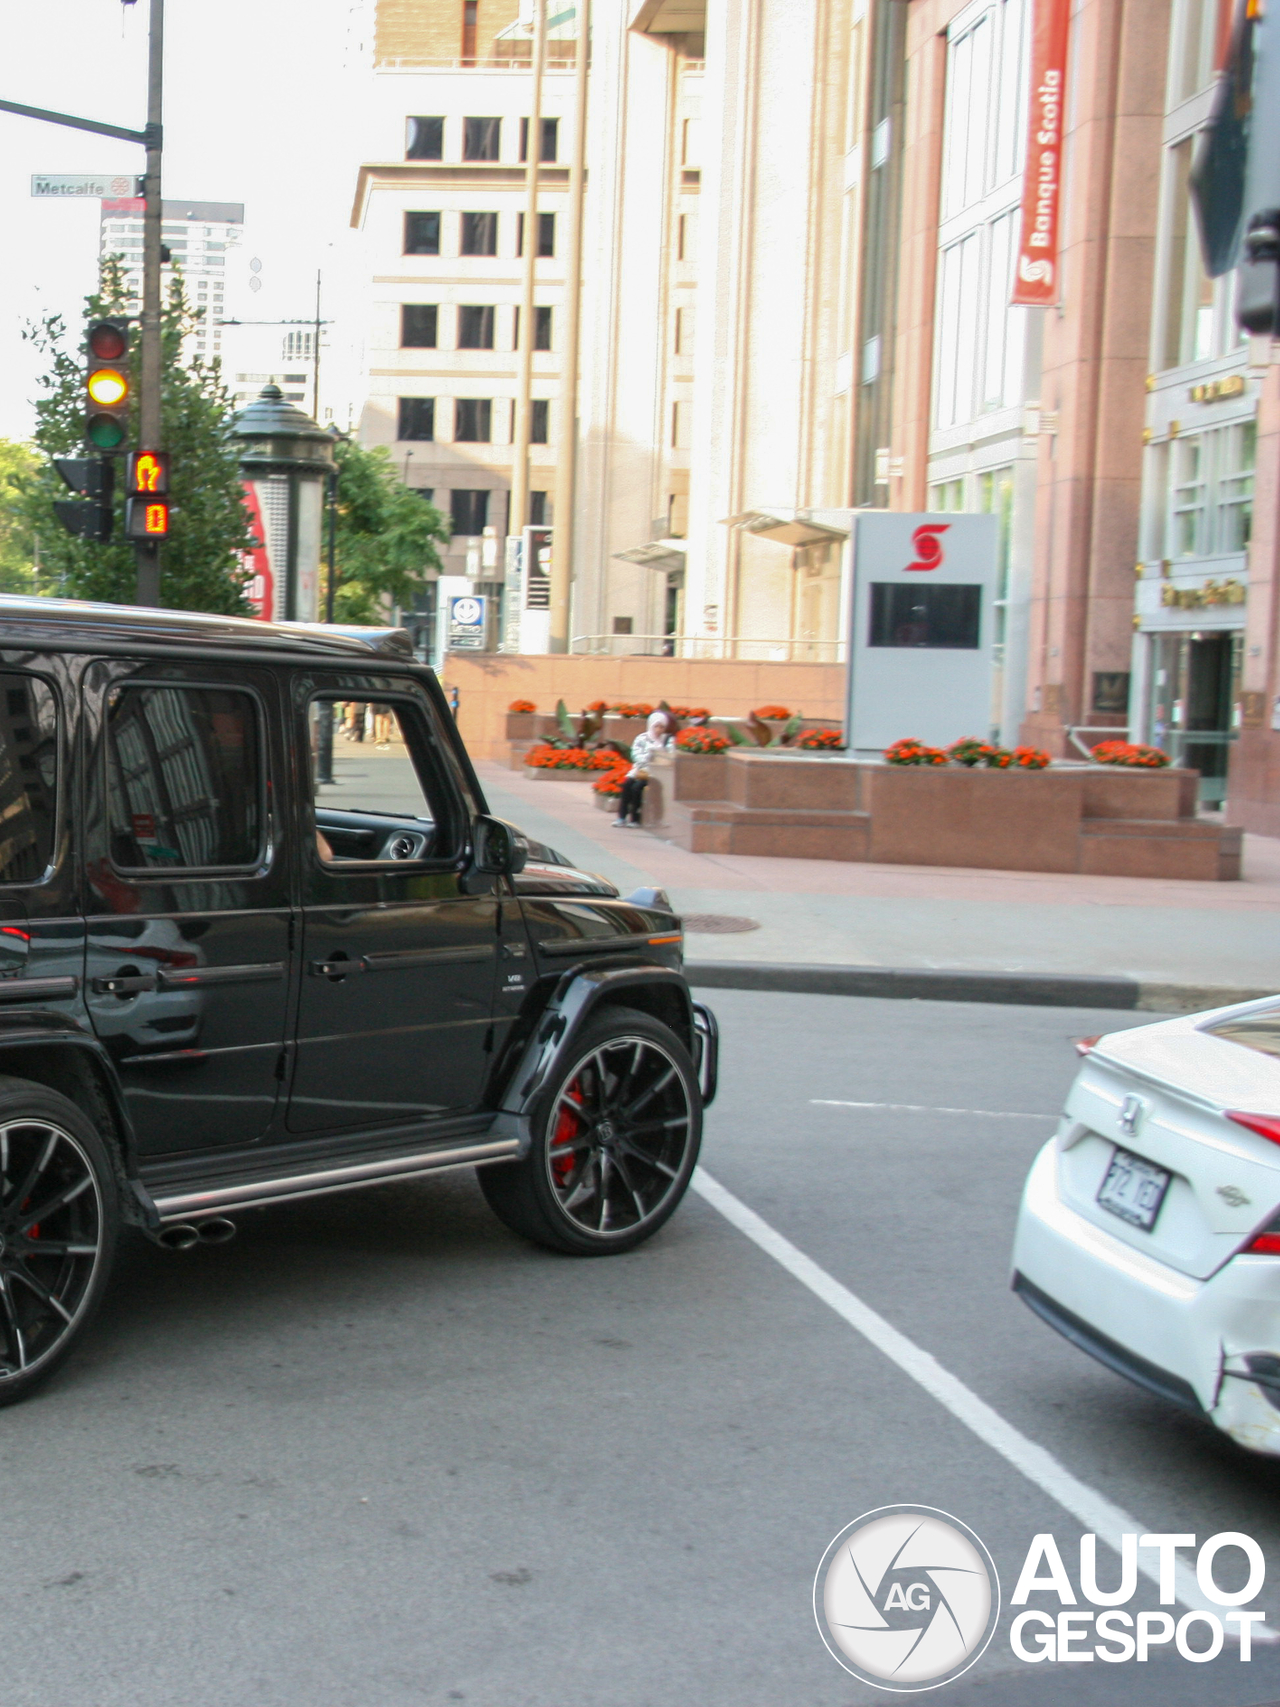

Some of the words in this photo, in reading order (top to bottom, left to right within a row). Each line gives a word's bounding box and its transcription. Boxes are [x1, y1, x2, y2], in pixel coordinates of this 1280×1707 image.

[1037, 69, 1061, 145] Scotia
[35, 181, 104, 195] Metcalfe
[1028, 151, 1057, 247] Banque
